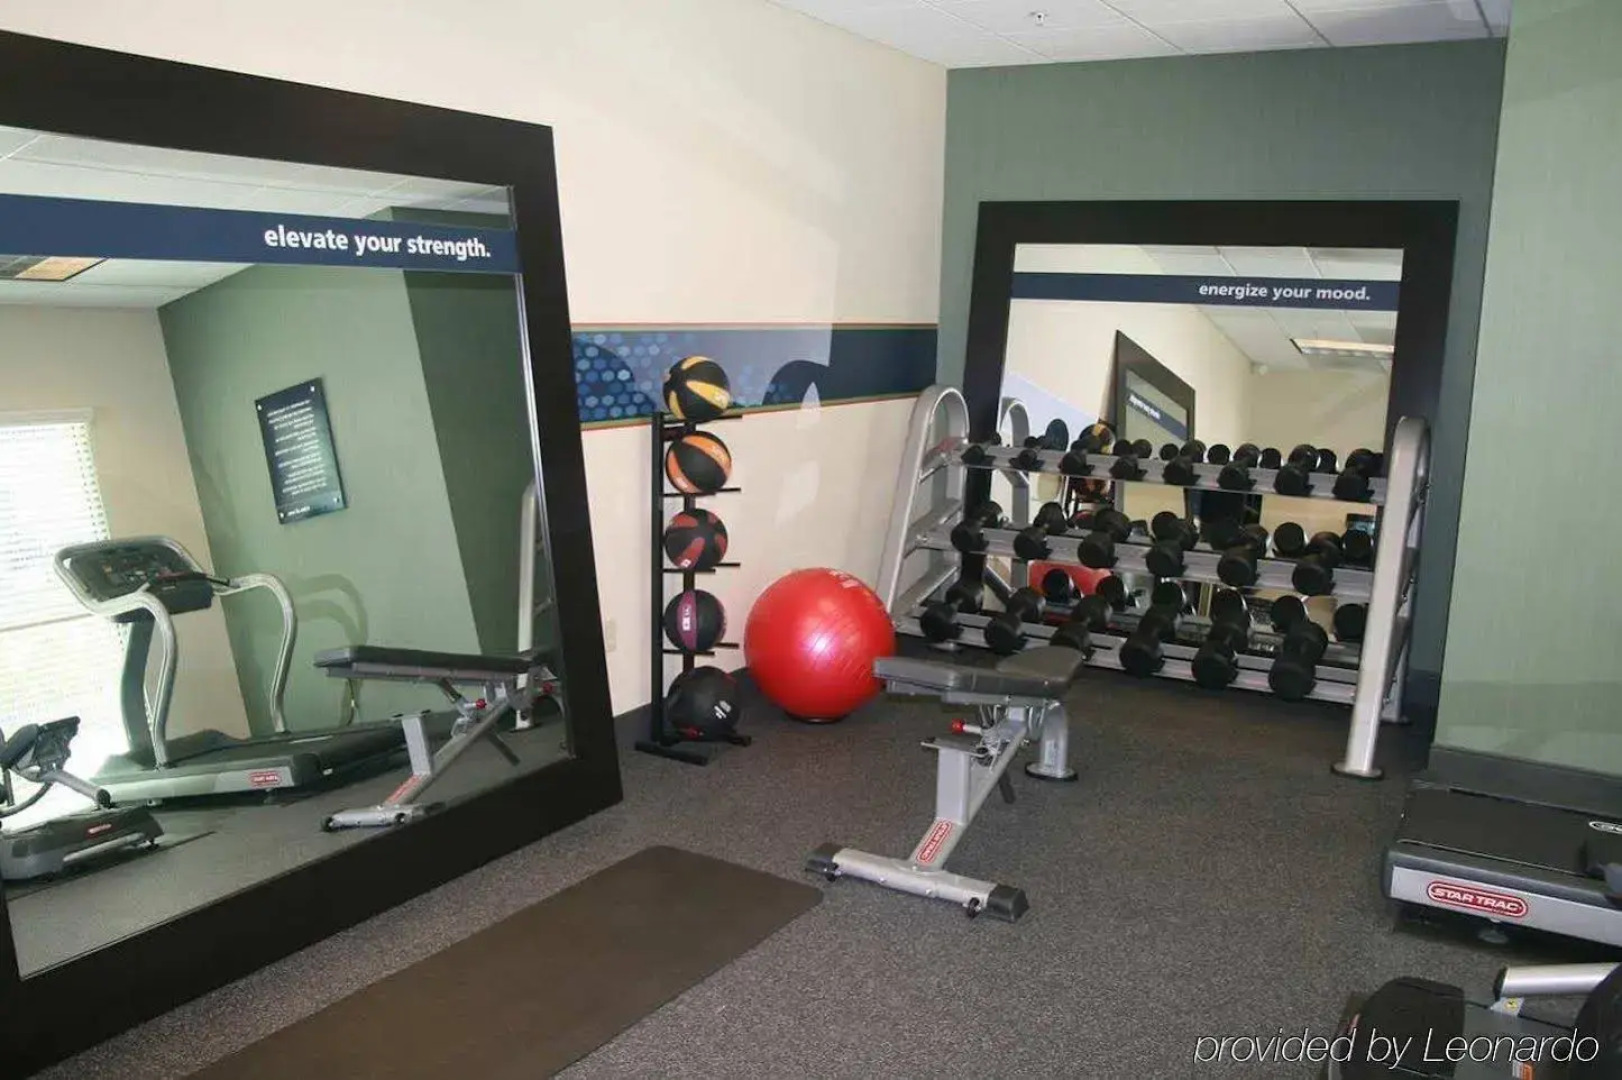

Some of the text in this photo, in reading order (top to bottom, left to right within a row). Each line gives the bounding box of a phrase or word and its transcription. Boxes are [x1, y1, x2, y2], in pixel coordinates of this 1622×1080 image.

[264, 224, 491, 260] elevate your strength.
[1198, 283, 1371, 301] energize your mood.
[1432, 887, 1519, 911] STAR TRAC
